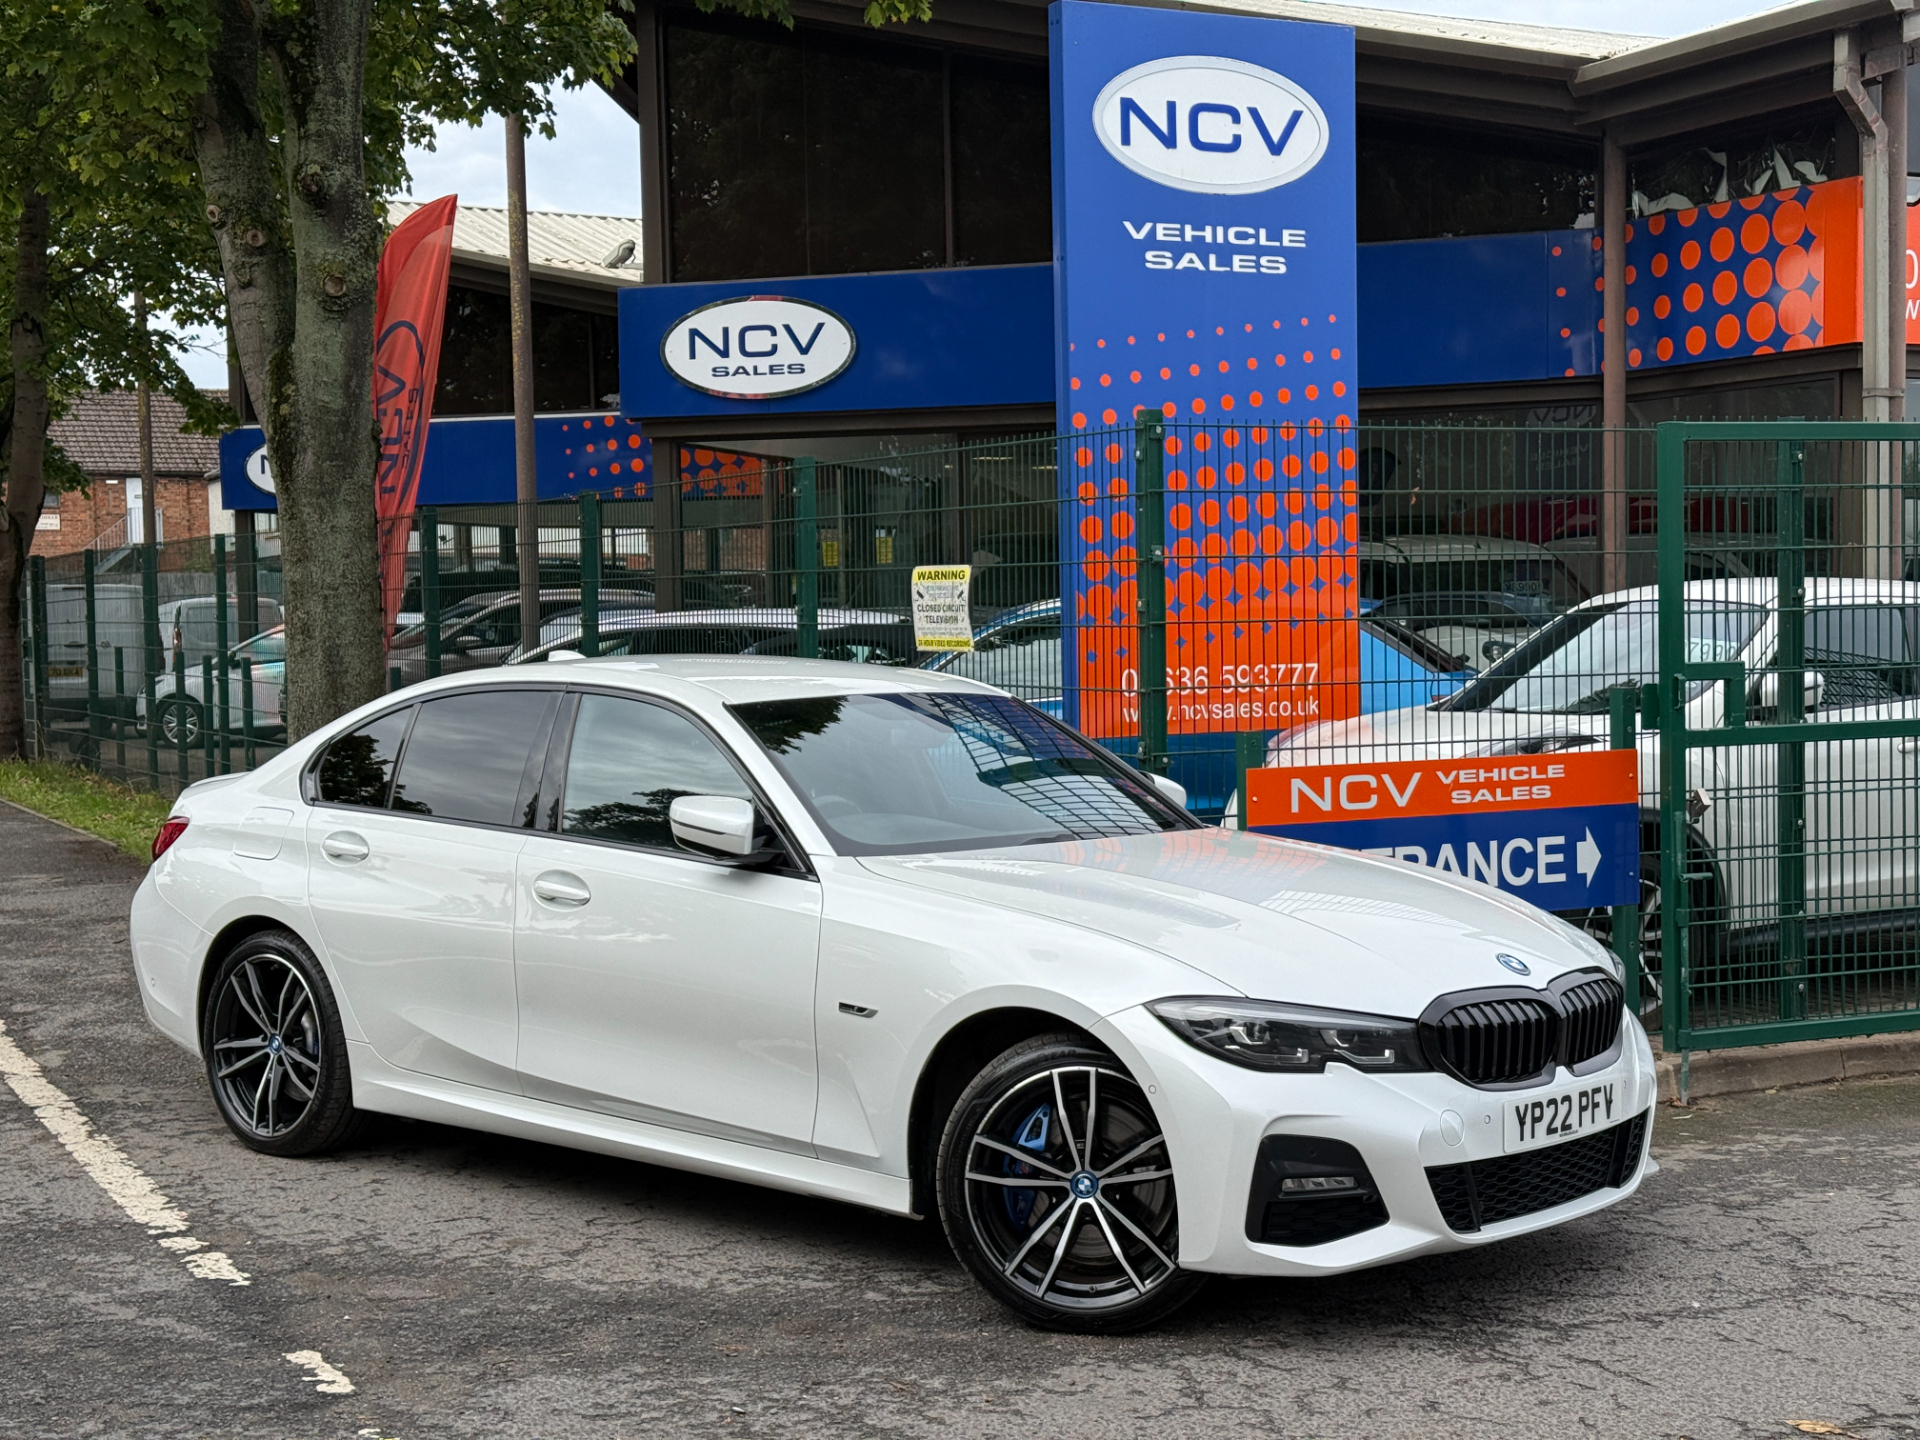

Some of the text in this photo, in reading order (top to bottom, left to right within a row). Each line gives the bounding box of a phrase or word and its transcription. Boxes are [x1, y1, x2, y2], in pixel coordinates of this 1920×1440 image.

[1120, 97, 1304, 156] NCV
[1122, 221, 1306, 248] VEHICLE
[1145, 250, 1287, 274] SALES
[688, 322, 826, 360] NCV
[711, 363, 806, 377] SALES
[917, 570, 965, 581] WARNING
[917, 604, 965, 613] CLOSED CIRCUIT
[925, 615, 959, 624] TELEVISION
[1219, 662, 1319, 695] 593777
[1436, 764, 1566, 785] VEHICLE
[1290, 772, 1422, 813] NCV
[1451, 784, 1551, 805] SALES
[1515, 1083, 1614, 1142] YP22 PFV
